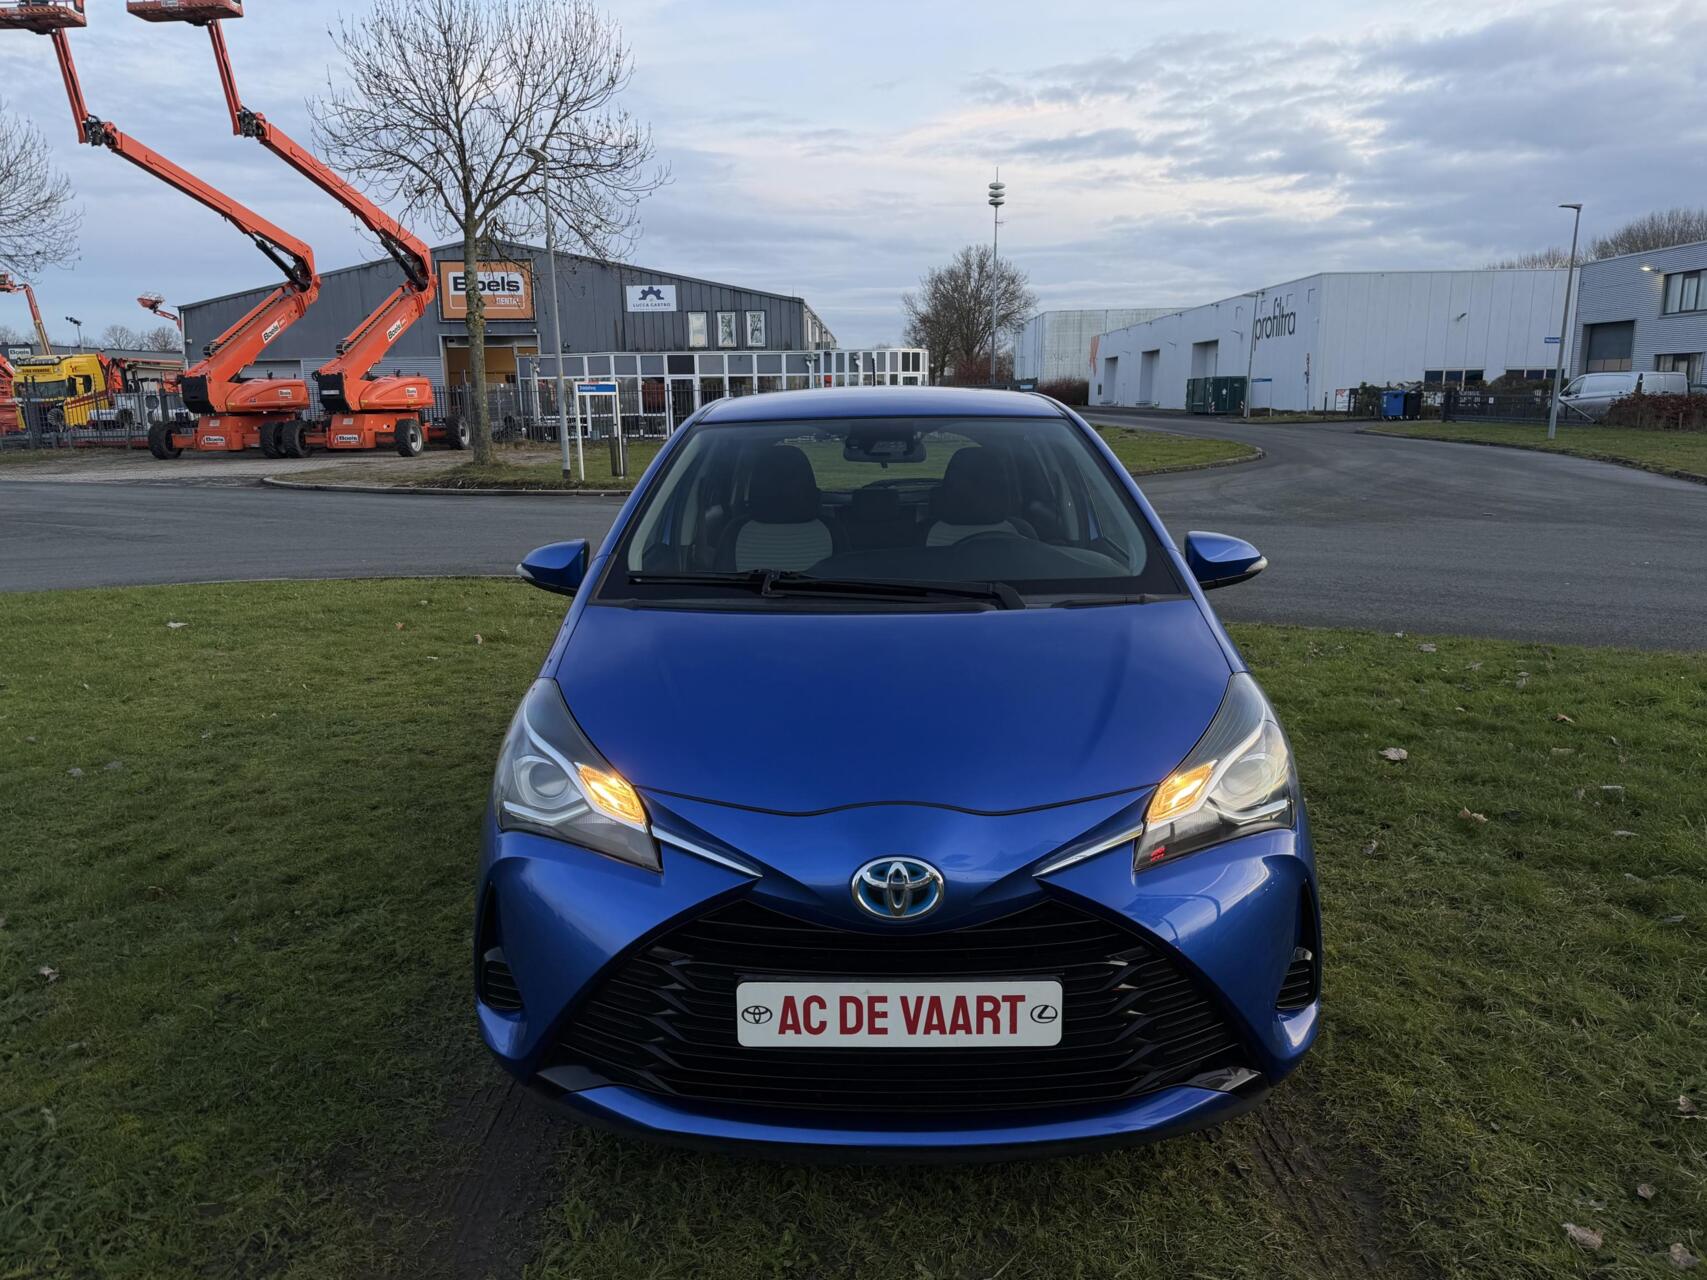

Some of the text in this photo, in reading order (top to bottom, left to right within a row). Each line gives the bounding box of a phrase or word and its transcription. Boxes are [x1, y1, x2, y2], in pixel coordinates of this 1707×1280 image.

[1253, 296, 1296, 352] profiltra
[778, 994, 1026, 1035] AC DE VAART
